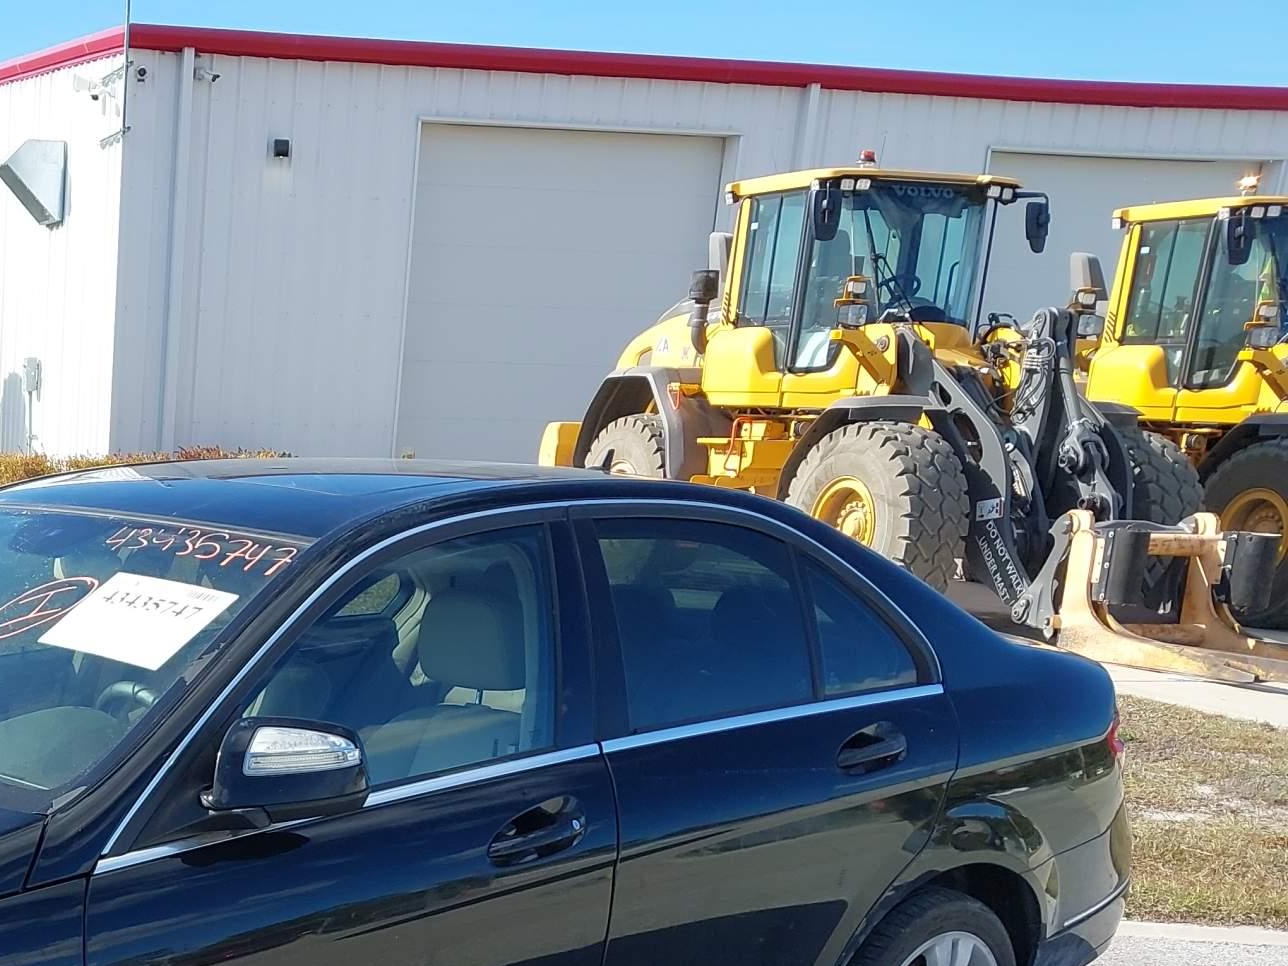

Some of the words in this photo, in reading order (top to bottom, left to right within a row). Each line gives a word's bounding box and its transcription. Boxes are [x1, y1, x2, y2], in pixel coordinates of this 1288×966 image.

[891, 185, 955, 199] VOLVO
[105, 526, 298, 576] 43435747
[978, 535, 999, 574] UNDER
[993, 571, 1011, 604] MAST
[985, 519, 999, 540] DO
[993, 537, 1011, 563] NOT
[1006, 559, 1027, 599] WALK
[103, 590, 204, 621] 43435747
